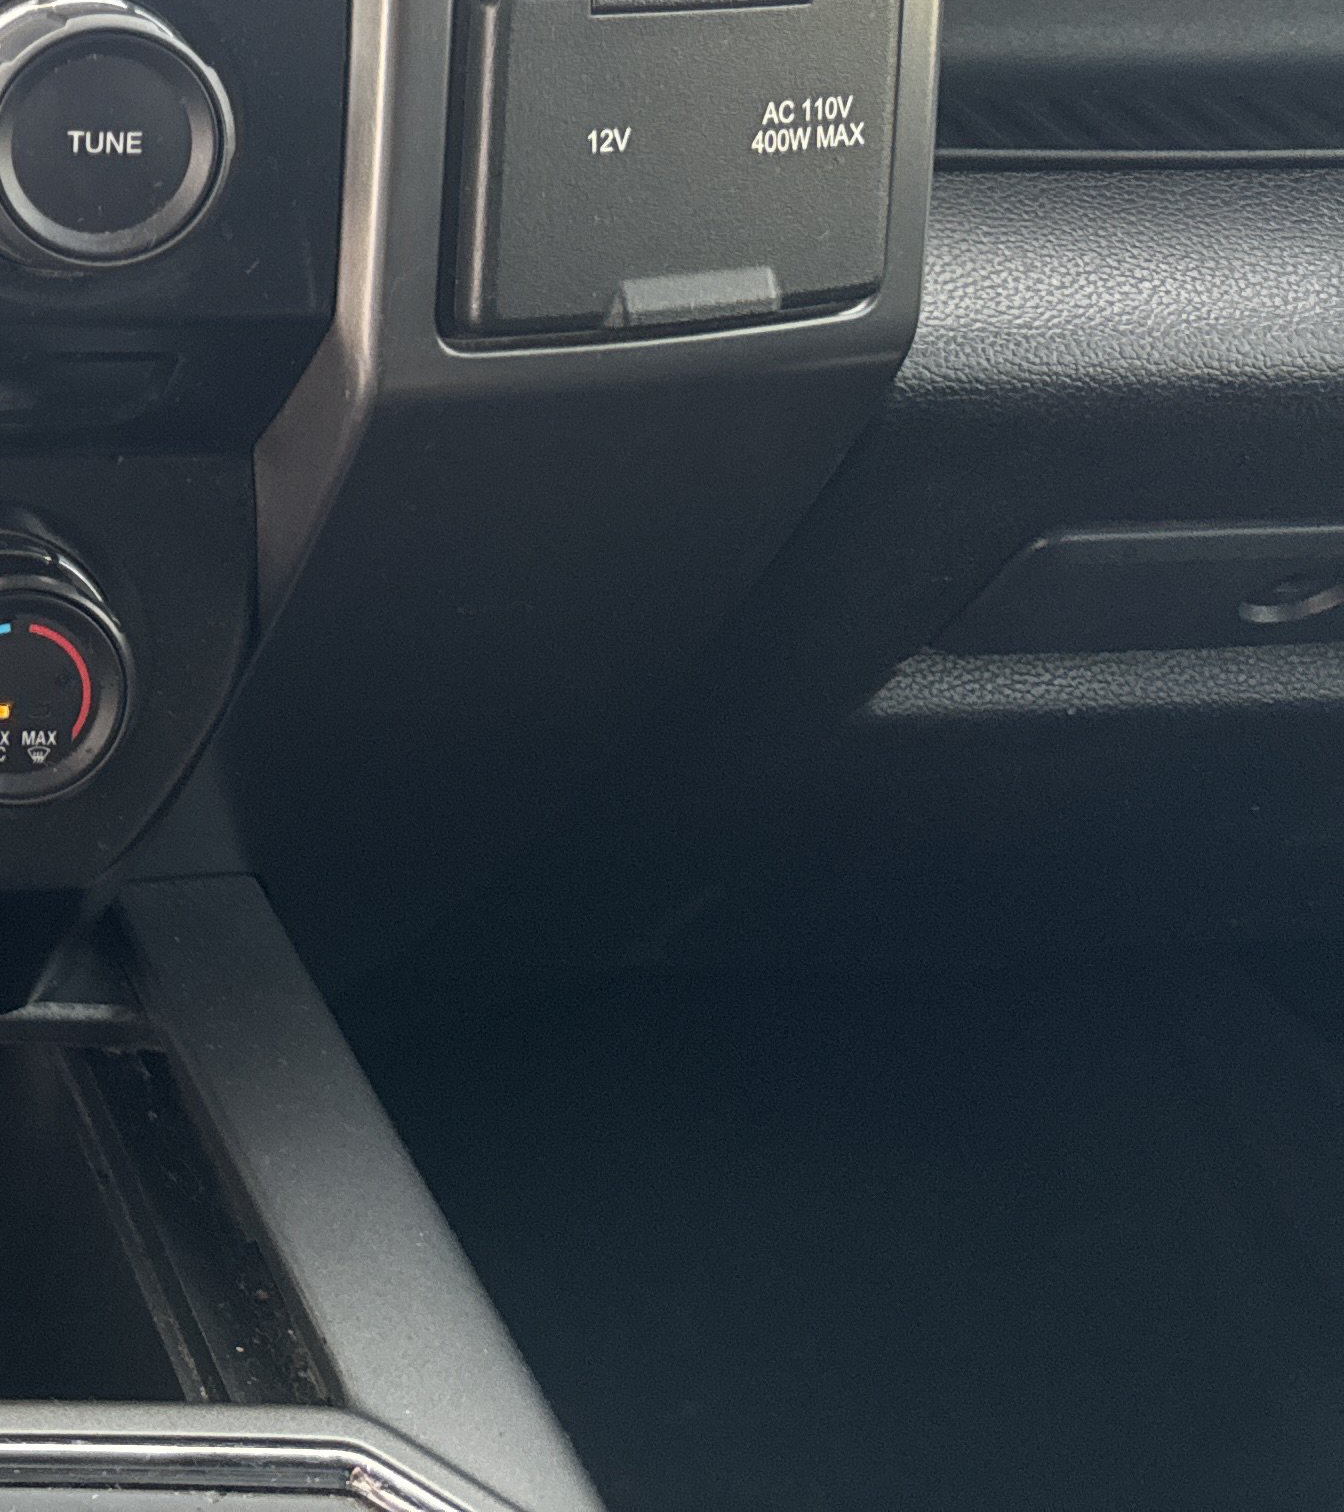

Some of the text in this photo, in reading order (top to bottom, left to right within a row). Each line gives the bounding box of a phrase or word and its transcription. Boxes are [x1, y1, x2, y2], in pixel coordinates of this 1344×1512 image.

[762, 94, 854, 125] AC 110V
[67, 130, 143, 155] TUNE
[587, 127, 631, 154] 12V
[751, 121, 865, 155] 400W MAX
[21, 730, 57, 746] MAX
